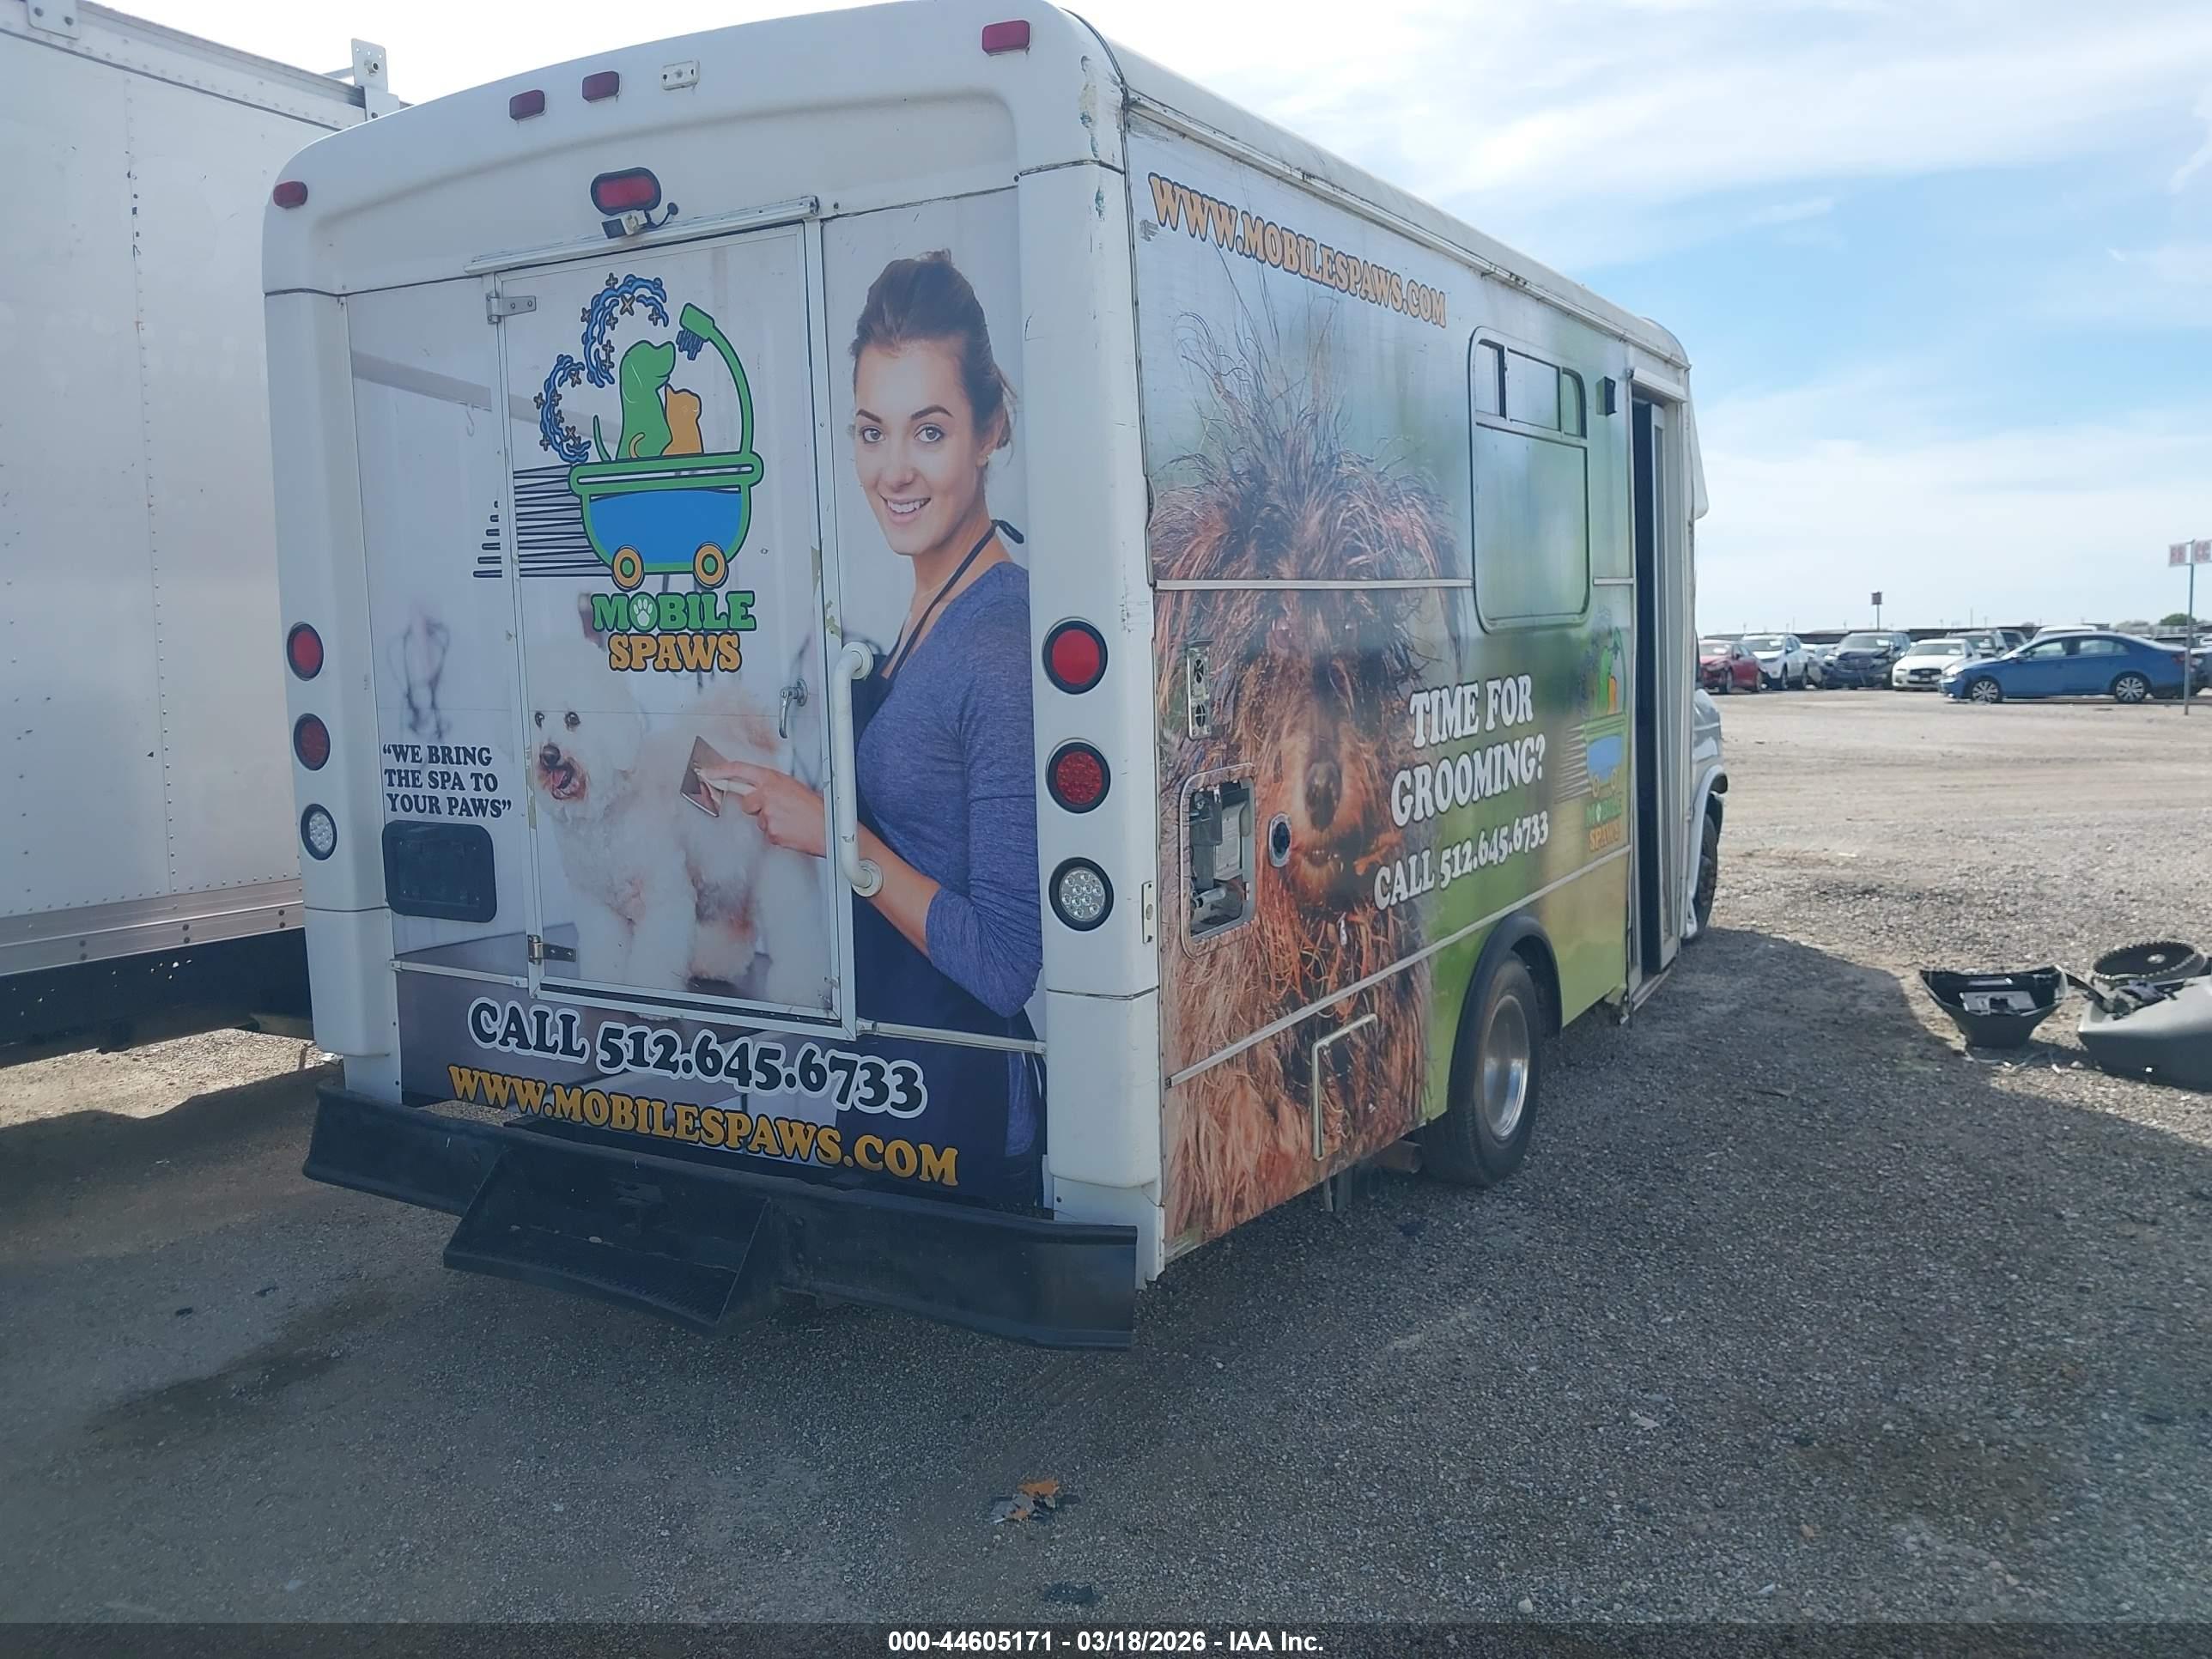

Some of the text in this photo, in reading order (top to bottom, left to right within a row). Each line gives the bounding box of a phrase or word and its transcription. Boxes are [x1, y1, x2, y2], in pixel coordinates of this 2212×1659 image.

[1148, 172, 1447, 328] WWW.MOBILESPAWS.COM
[591, 591, 757, 631] MOBILE
[608, 633, 742, 672] SPAWS
[1409, 674, 1534, 748] TIME FOR
[384, 769, 498, 792] THE SPA TO
[427, 745, 492, 766] BRING
[1391, 733, 1546, 827] GROOMING?
[386, 793, 442, 815] YOUR
[1375, 811, 1548, 910] CALL 512.645.6733
[469, 998, 927, 1118] CALL 512.645.6733
[447, 1065, 959, 1187] WWW.MOBILESPAWS.COM
